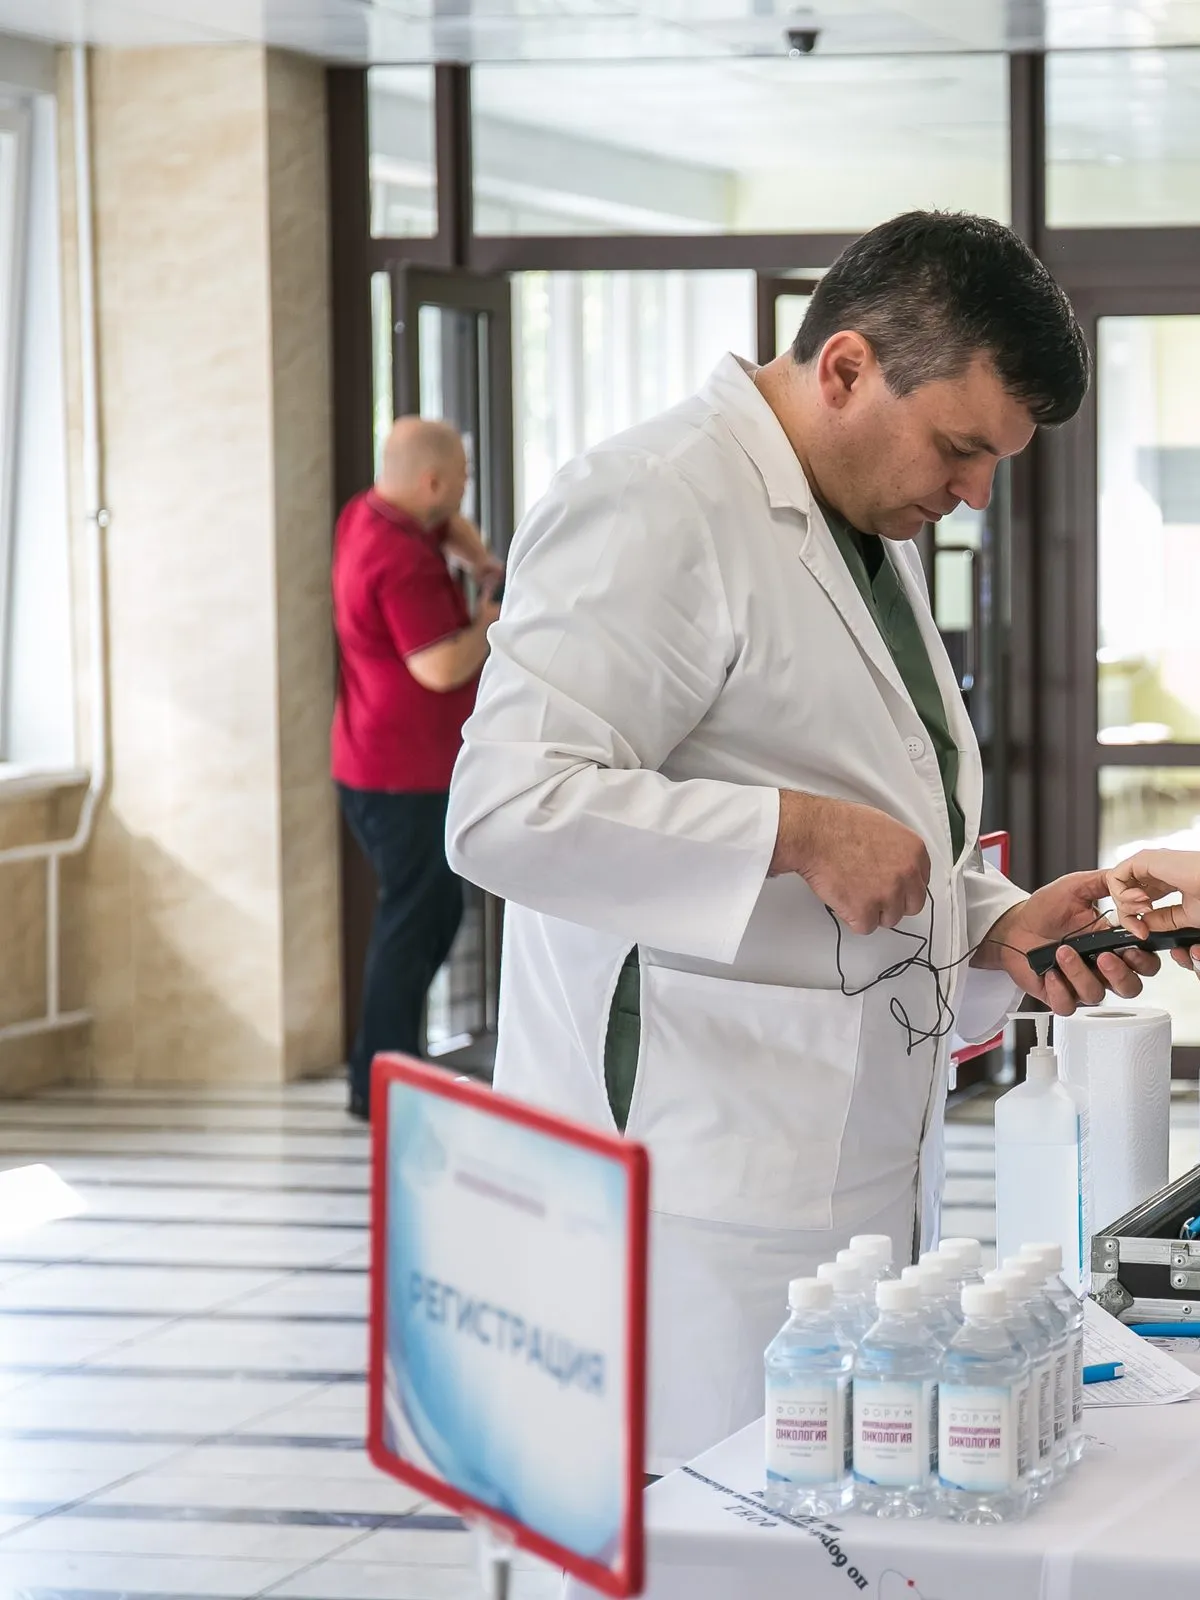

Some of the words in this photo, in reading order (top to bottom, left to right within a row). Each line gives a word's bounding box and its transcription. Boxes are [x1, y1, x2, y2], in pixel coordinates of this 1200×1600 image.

[409, 1270, 606, 1398] РЕГИСТРАЦИЯ
[776, 1406, 828, 1416] ФОРУМ
[862, 1408, 912, 1418] ФОРУМ
[949, 1413, 1001, 1423] ФОРУМ
[775, 1428, 828, 1441] ОНКОЛОГИЯ
[862, 1430, 912, 1443] ОНКОЛОГИЯ
[949, 1436, 1001, 1449] ОНКОЛОГИЯ
[847, 1566, 869, 1590] по
